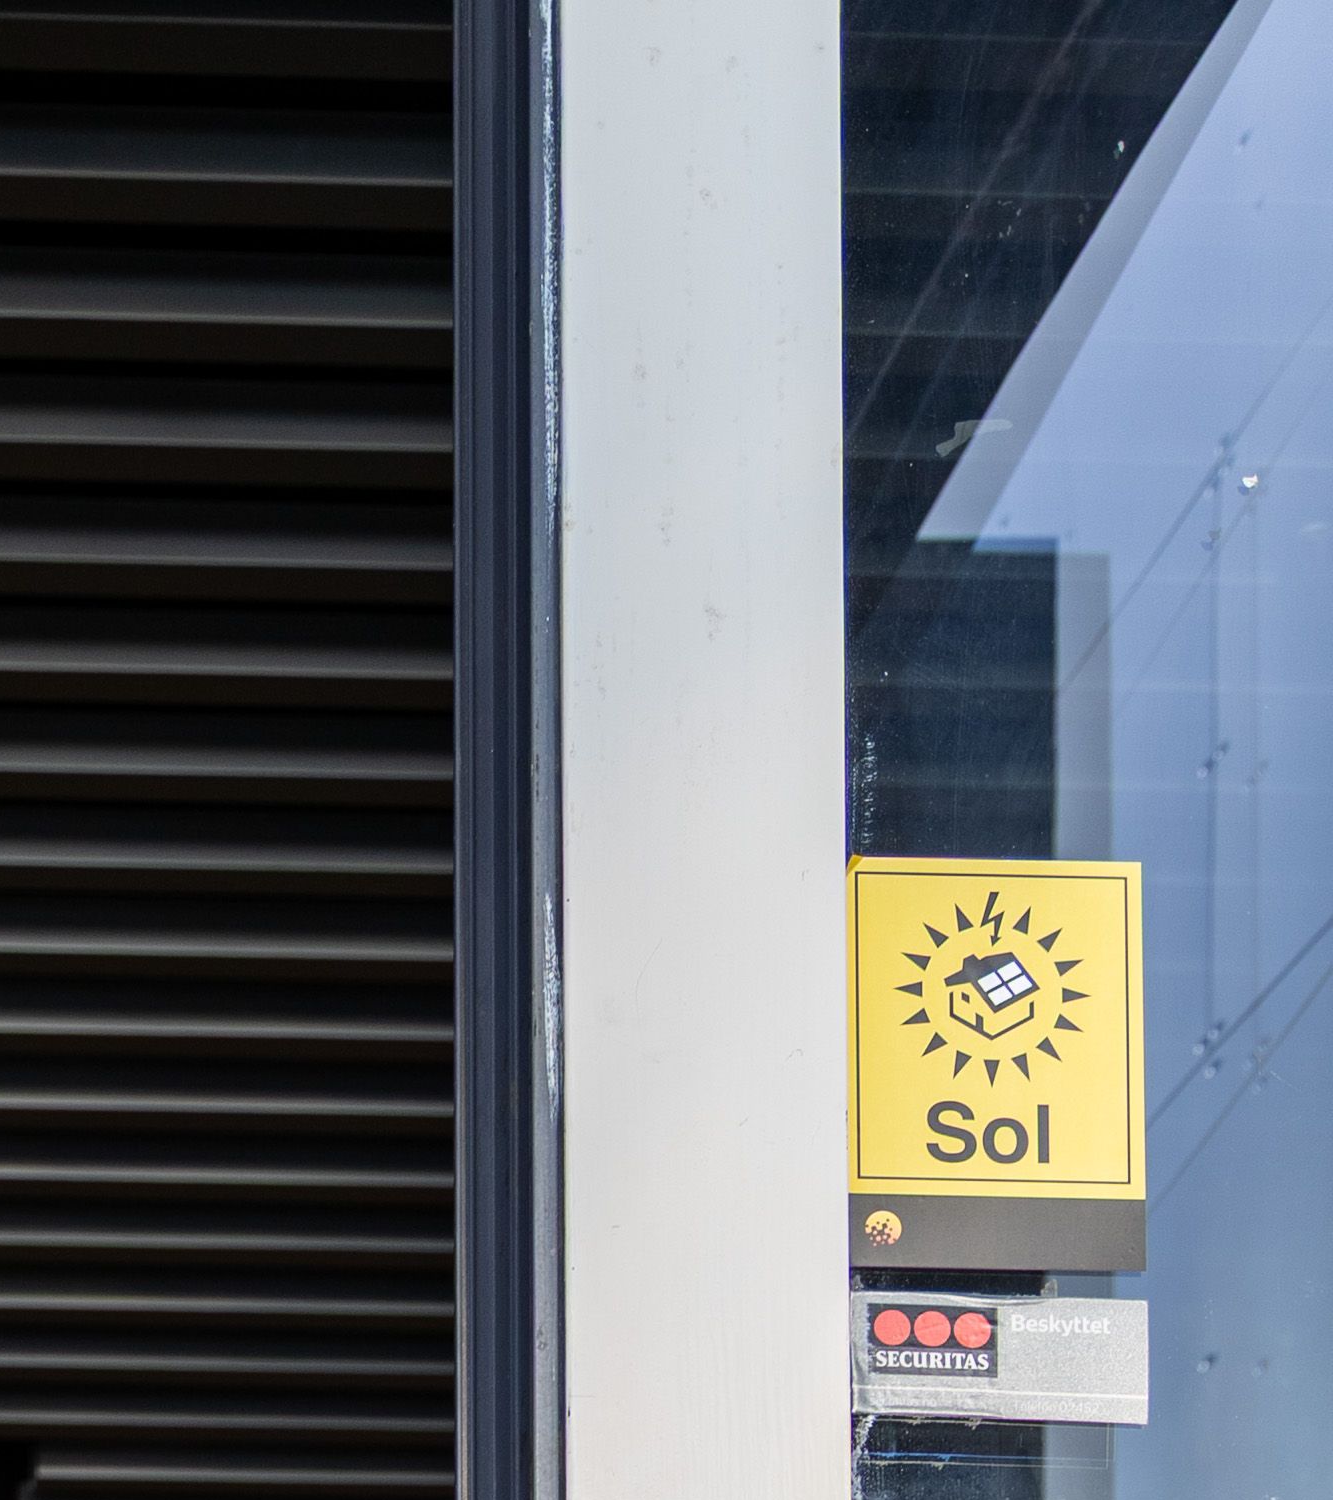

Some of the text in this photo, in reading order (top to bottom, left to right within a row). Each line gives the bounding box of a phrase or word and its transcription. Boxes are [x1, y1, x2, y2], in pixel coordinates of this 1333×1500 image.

[925, 1100, 1050, 1164] Sol
[1010, 1313, 1111, 1337] Beskyttet
[875, 1349, 990, 1370] SECURITAS
